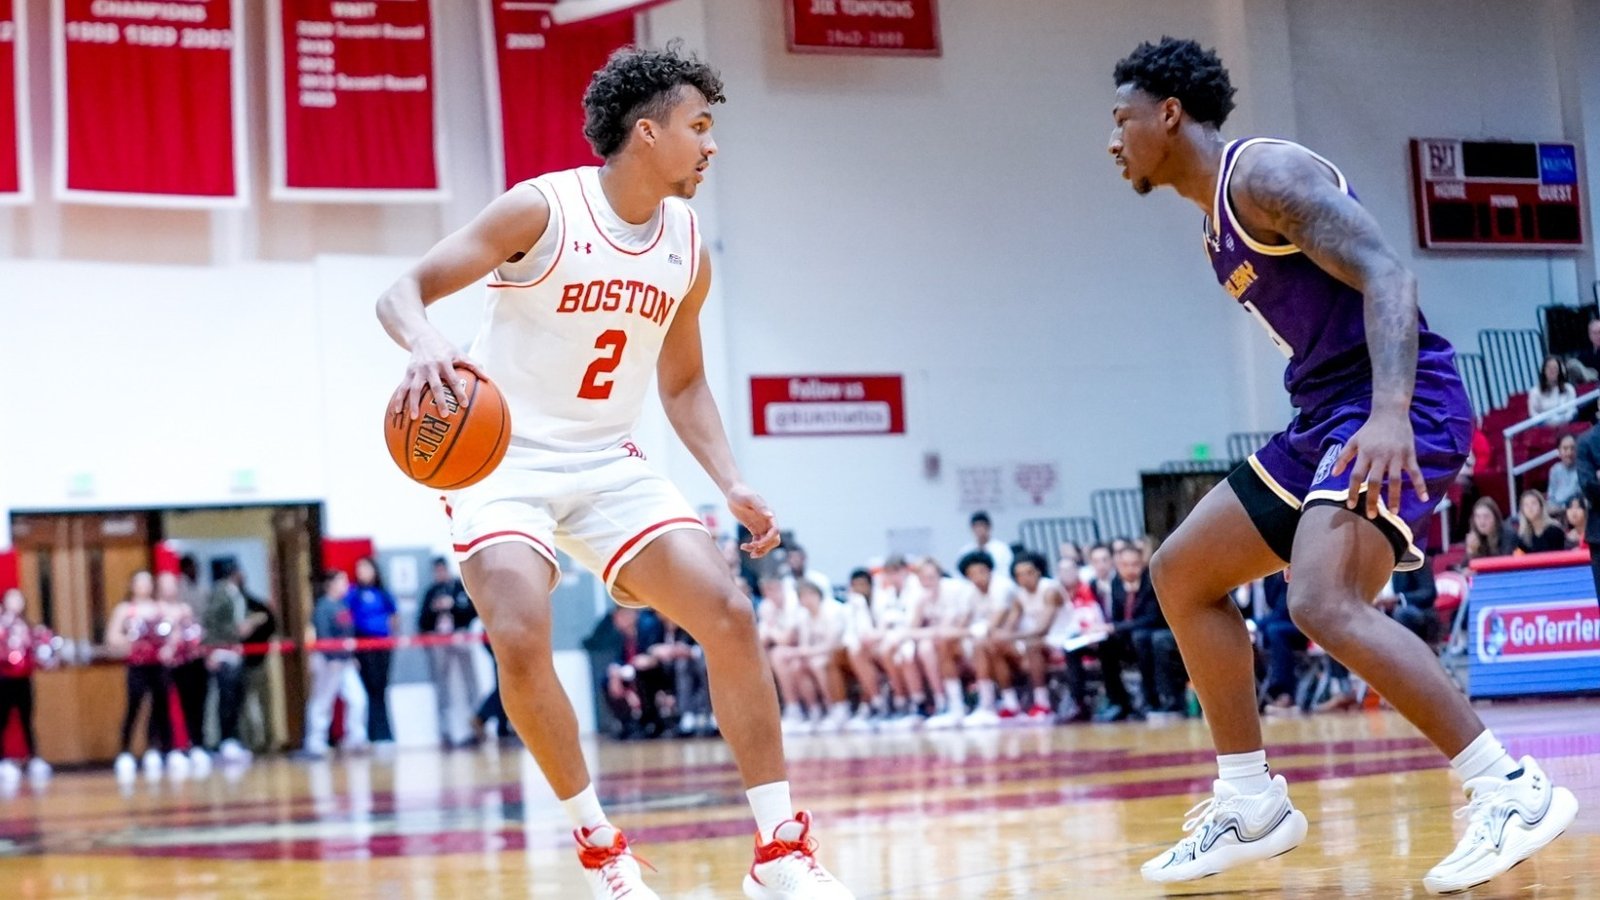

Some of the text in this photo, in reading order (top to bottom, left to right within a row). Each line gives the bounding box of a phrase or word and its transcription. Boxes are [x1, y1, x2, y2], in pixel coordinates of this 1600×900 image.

[1538, 184, 1572, 202] GUEST
[556, 279, 675, 327] BOSTON
[577, 329, 627, 399] 2
[788, 376, 865, 400] Follow us
[413, 412, 452, 463] ROCK
